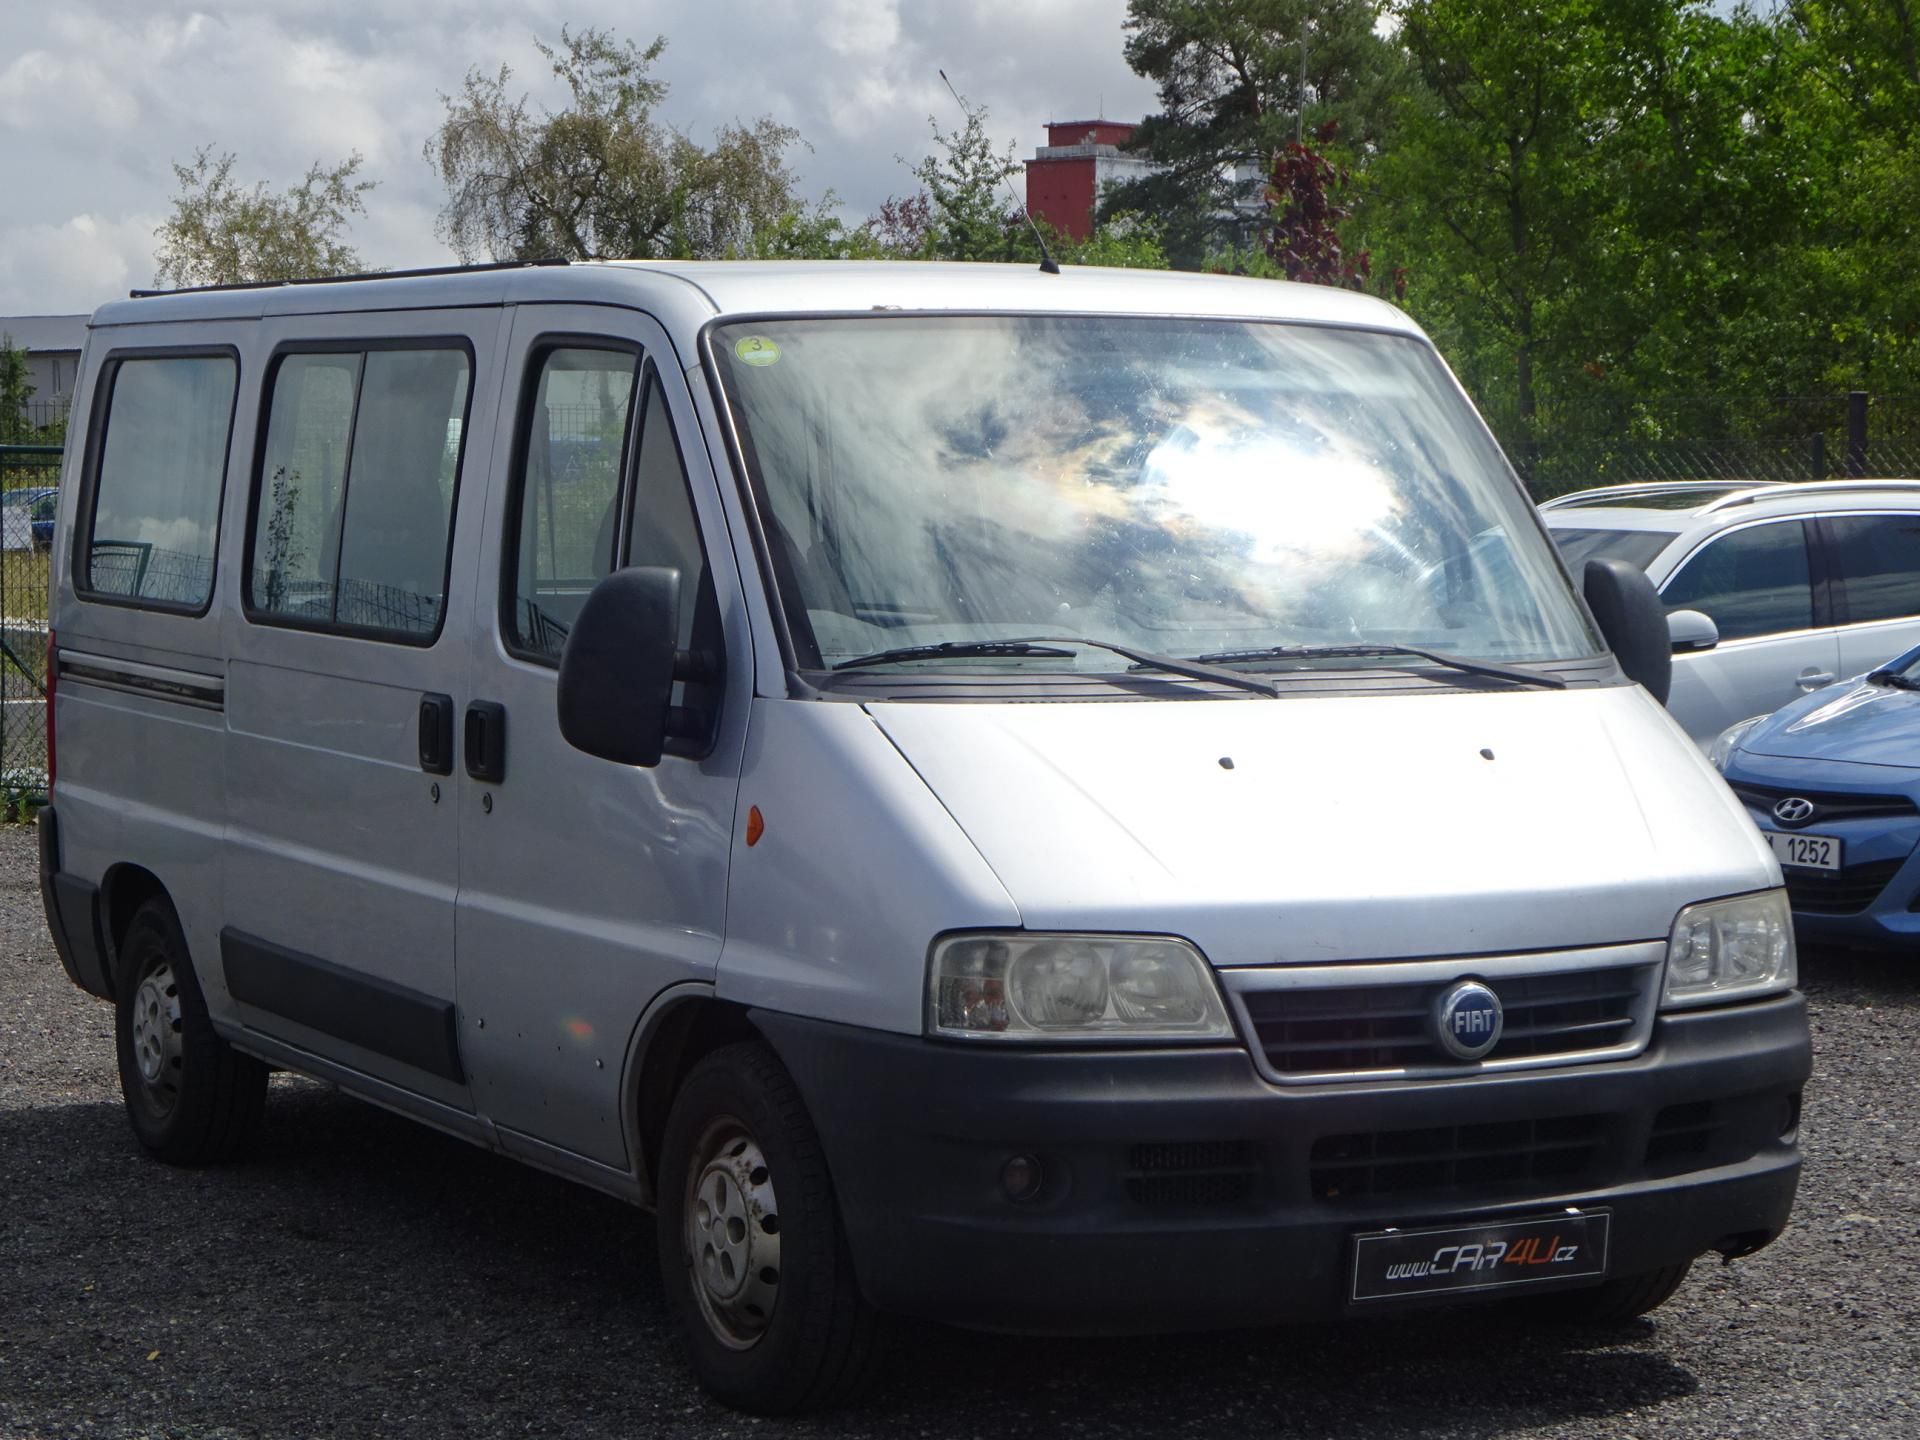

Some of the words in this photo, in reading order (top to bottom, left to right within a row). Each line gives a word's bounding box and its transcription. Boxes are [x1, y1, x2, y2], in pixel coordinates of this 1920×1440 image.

[751, 337, 763, 352] 3
[1787, 837, 1831, 866] 1252
[1455, 1009, 1495, 1034] FIAT
